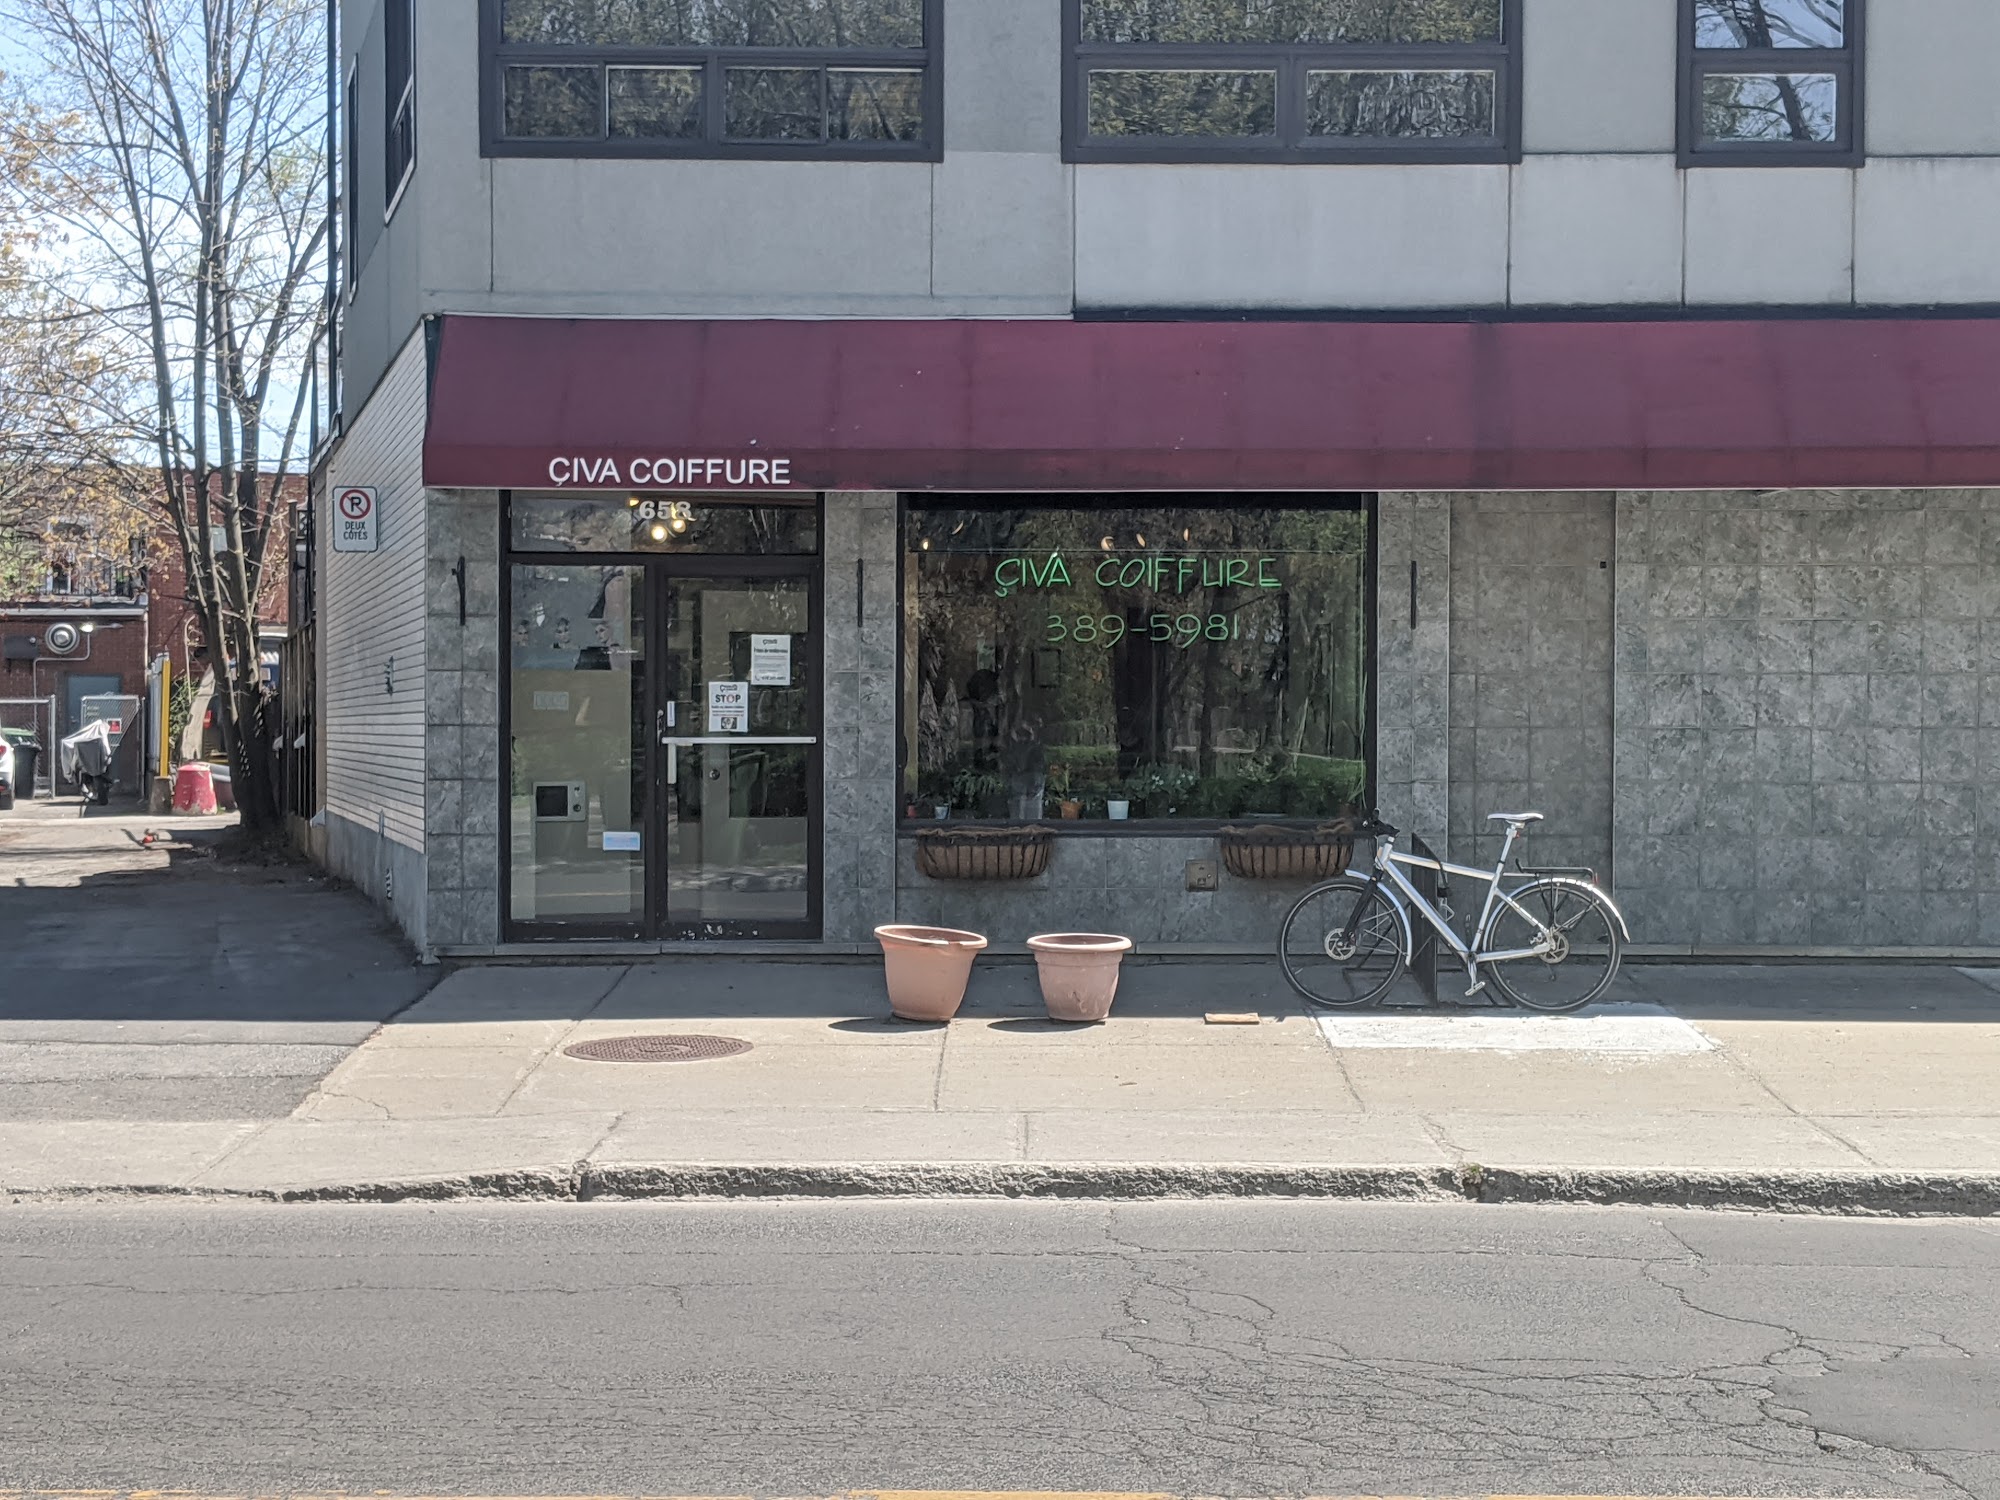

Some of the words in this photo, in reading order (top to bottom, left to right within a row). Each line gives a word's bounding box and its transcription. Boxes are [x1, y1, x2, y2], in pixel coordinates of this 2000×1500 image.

[549, 457, 621, 486] ÇIVA
[629, 458, 790, 484] COIFFURE
[639, 501, 691, 519] 658
[345, 521, 365, 530] DEUX
[995, 555, 1071, 597] ÇIVA
[1095, 557, 1282, 594] COIFFURE
[1047, 614, 1239, 648] 389-5981
[715, 694, 741, 703] STOP
